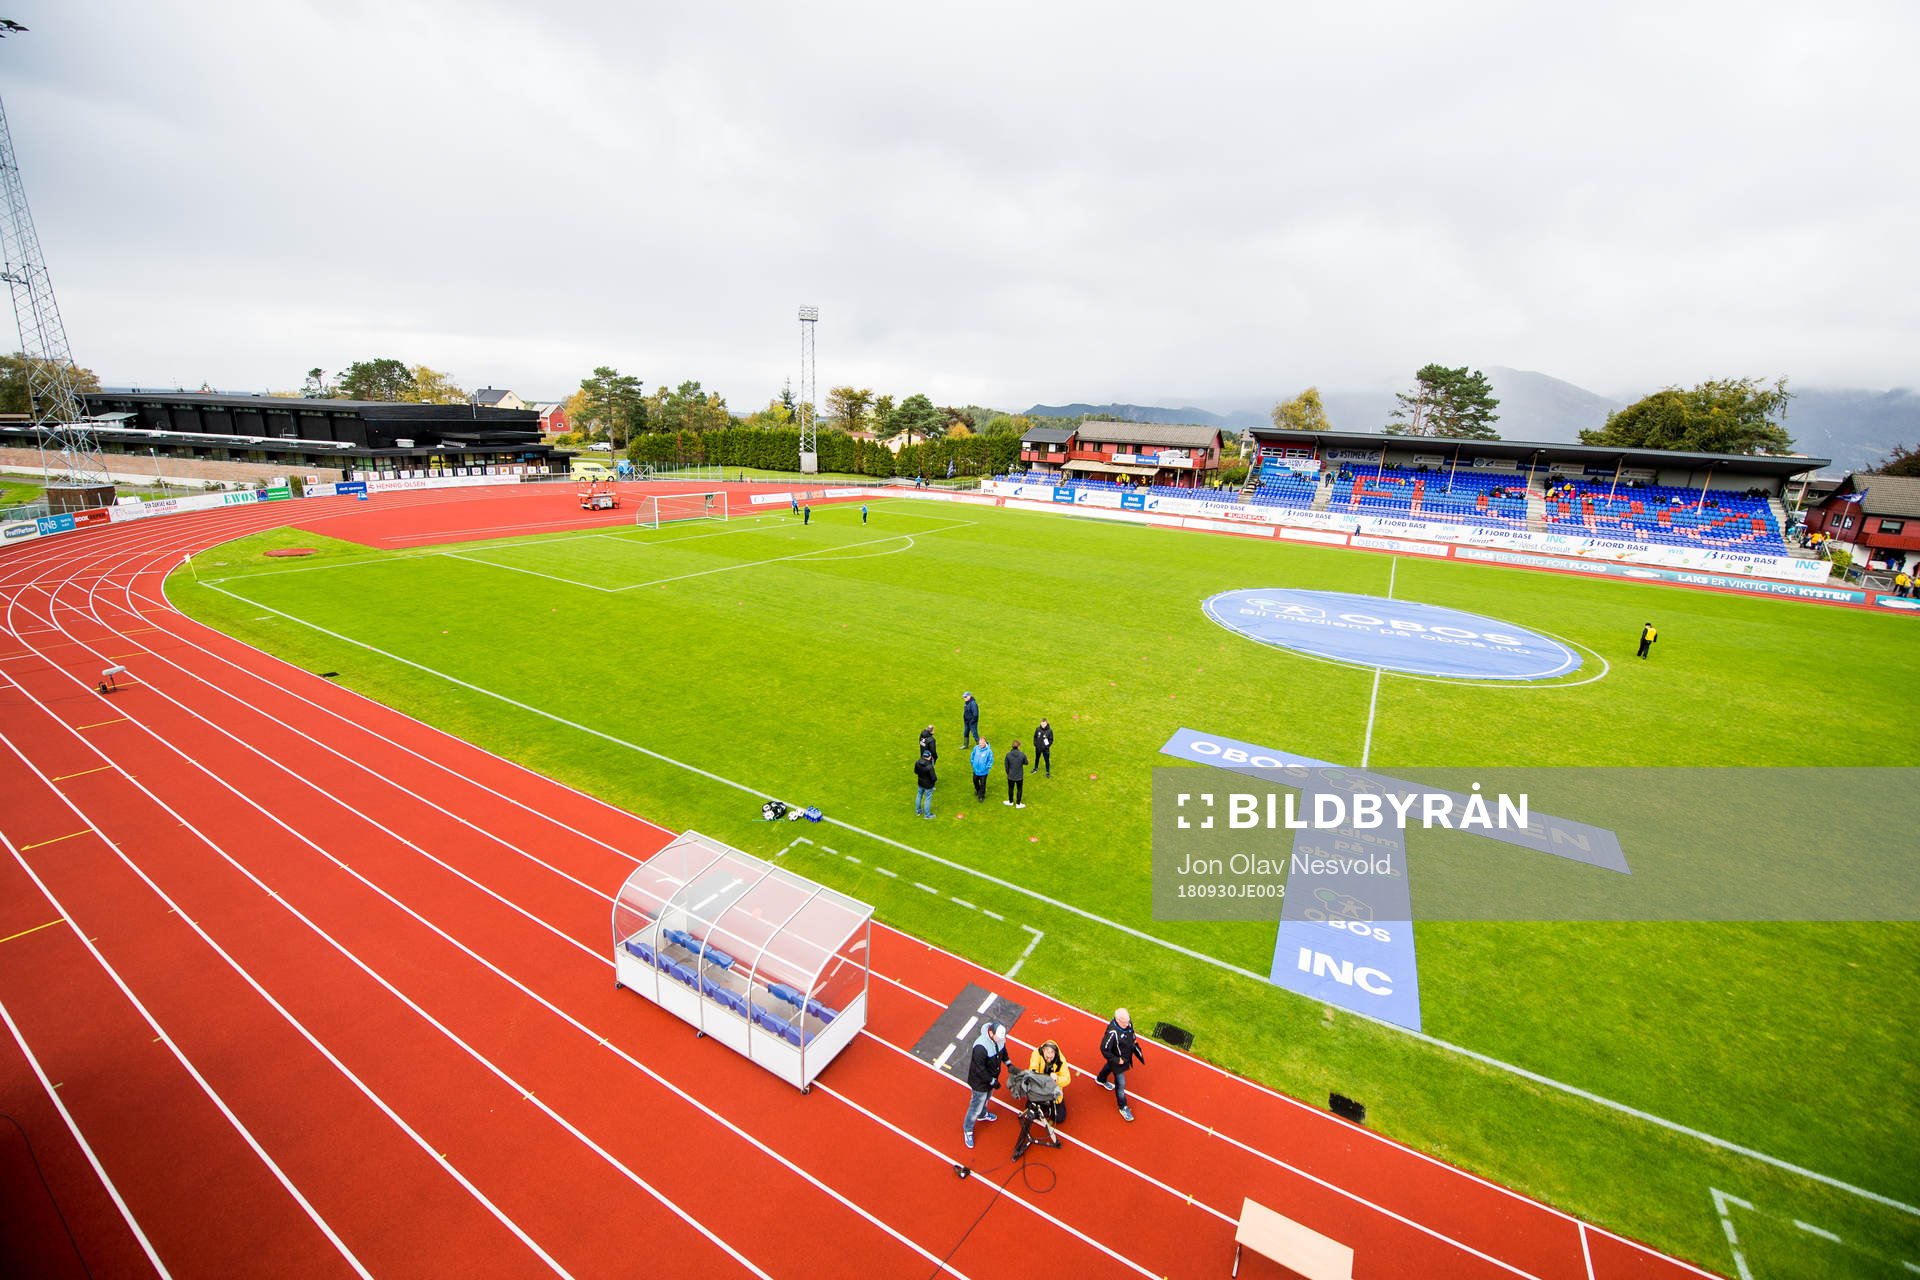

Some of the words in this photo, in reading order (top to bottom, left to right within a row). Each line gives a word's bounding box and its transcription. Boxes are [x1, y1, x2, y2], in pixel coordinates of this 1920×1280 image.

[223, 491, 256, 504] EWOS
[1209, 503, 1229, 511] FJORD
[1315, 512, 1332, 520] BASE
[40, 520, 57, 532] DNB
[1384, 520, 1407, 528] FJORD
[1409, 522, 1427, 530] BASE
[1485, 529, 1510, 538] FJORD
[1512, 532, 1533, 540] BASE
[1546, 535, 1567, 544] INC
[1357, 539, 1386, 549] OBOS
[1403, 543, 1441, 555] LIGAEN
[1596, 540, 1625, 549] FJORD
[1626, 543, 1649, 552] BASE
[1720, 553, 1751, 563] FJORD
[1753, 557, 1778, 566] BASE
[1795, 560, 1820, 570] INC
[1677, 574, 1709, 585] LAKS
[1711, 577, 1726, 587] ER
[1727, 579, 1769, 592] VIKTIG
[1771, 585, 1796, 595] FOR
[1799, 587, 1852, 601] KYSTEN
[1240, 608, 1267, 617] Bli
[1276, 614, 1371, 631] medlem
[1420, 634, 1532, 655] obos.no
[1340, 613, 1524, 646] OBOS
[1190, 741, 1311, 779] OBOS
[1303, 908, 1392, 943] OBOS
[1297, 947, 1393, 996] INC
